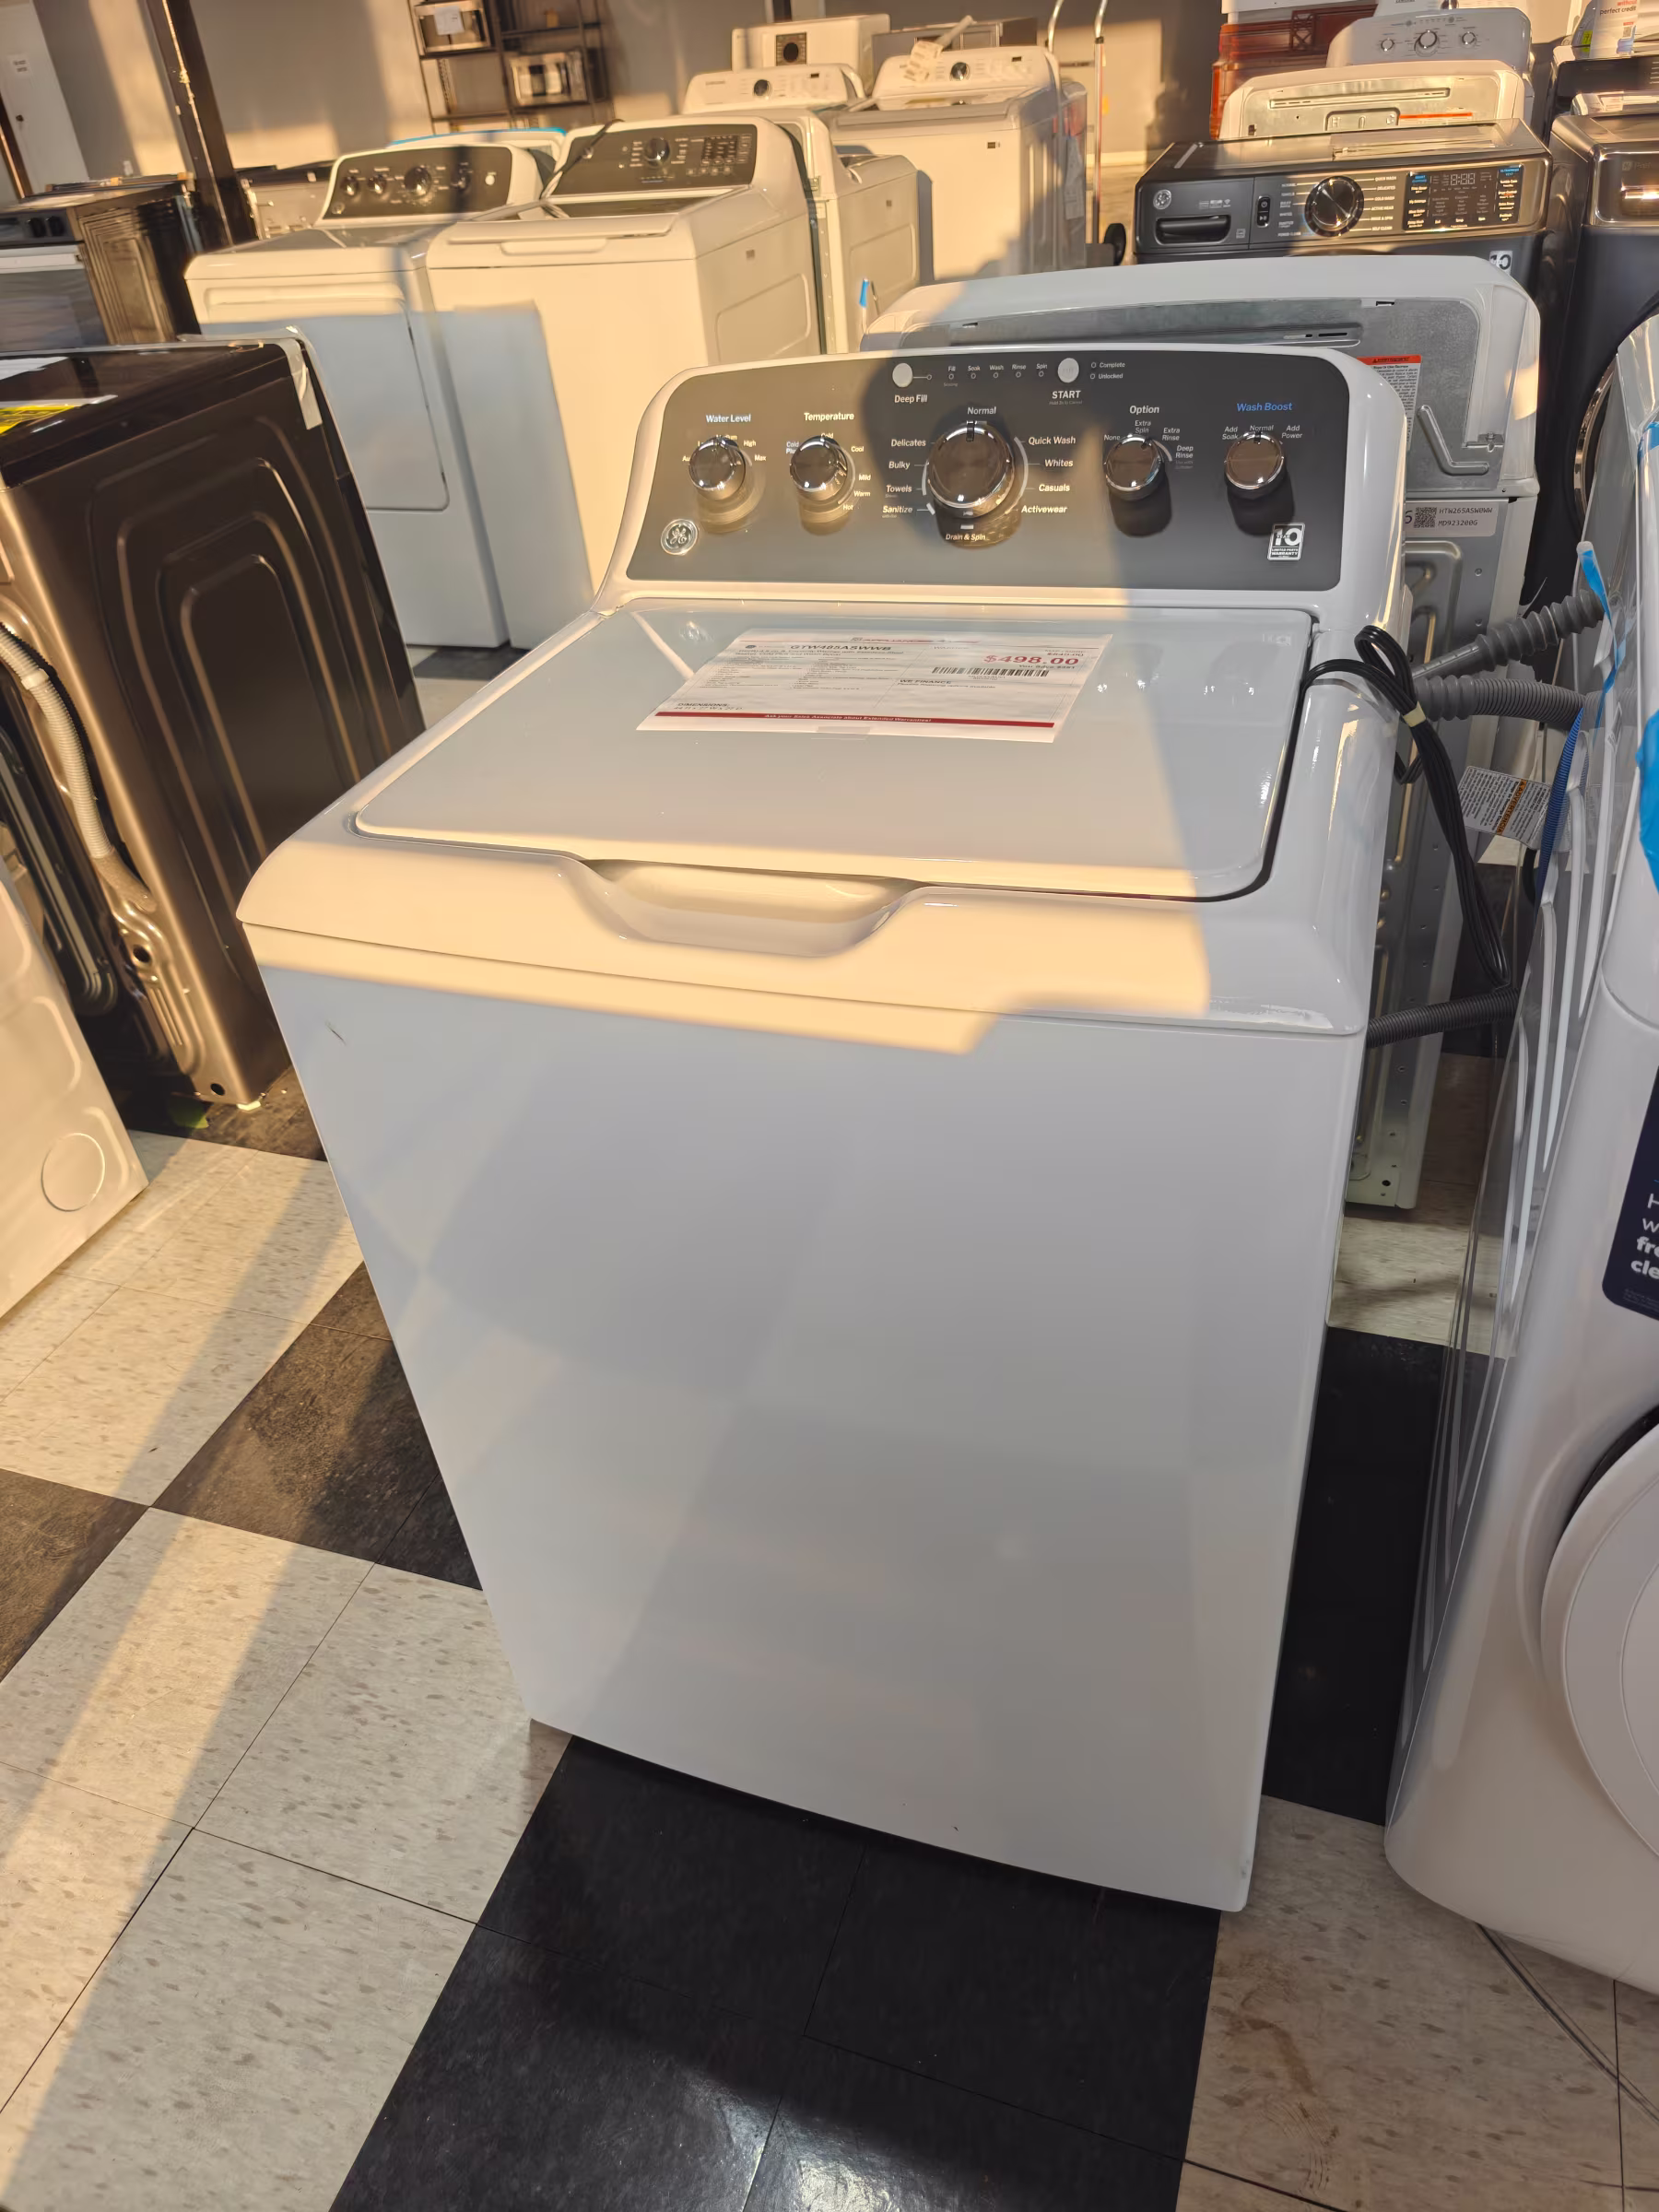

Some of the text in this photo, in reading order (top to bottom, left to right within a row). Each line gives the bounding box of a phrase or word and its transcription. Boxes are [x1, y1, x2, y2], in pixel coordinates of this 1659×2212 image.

[894, 394, 927, 404] Deep Fill
[1052, 390, 1081, 399] START
[967, 406, 996, 415] Normal
[1129, 405, 1160, 415] Option
[1236, 402, 1293, 412] Wash Boost
[705, 413, 752, 423] Water Level
[804, 413, 854, 422] Temperature
[743, 440, 757, 448] High
[890, 439, 926, 447] Delicates
[1028, 436, 1077, 446] Quick Wash
[888, 461, 911, 470] Bulky
[1044, 459, 1074, 467] Whites
[886, 485, 912, 493] Towels
[1038, 484, 1071, 492] Casuals
[882, 505, 913, 514] Sanitize
[1020, 505, 1068, 513] Activewear
[971, 534, 986, 542] Spin
[1273, 527, 1302, 547] 10
[983, 655, 1079, 665] $498.00
[1497, 784, 1524, 833] ADVERTENCIA
